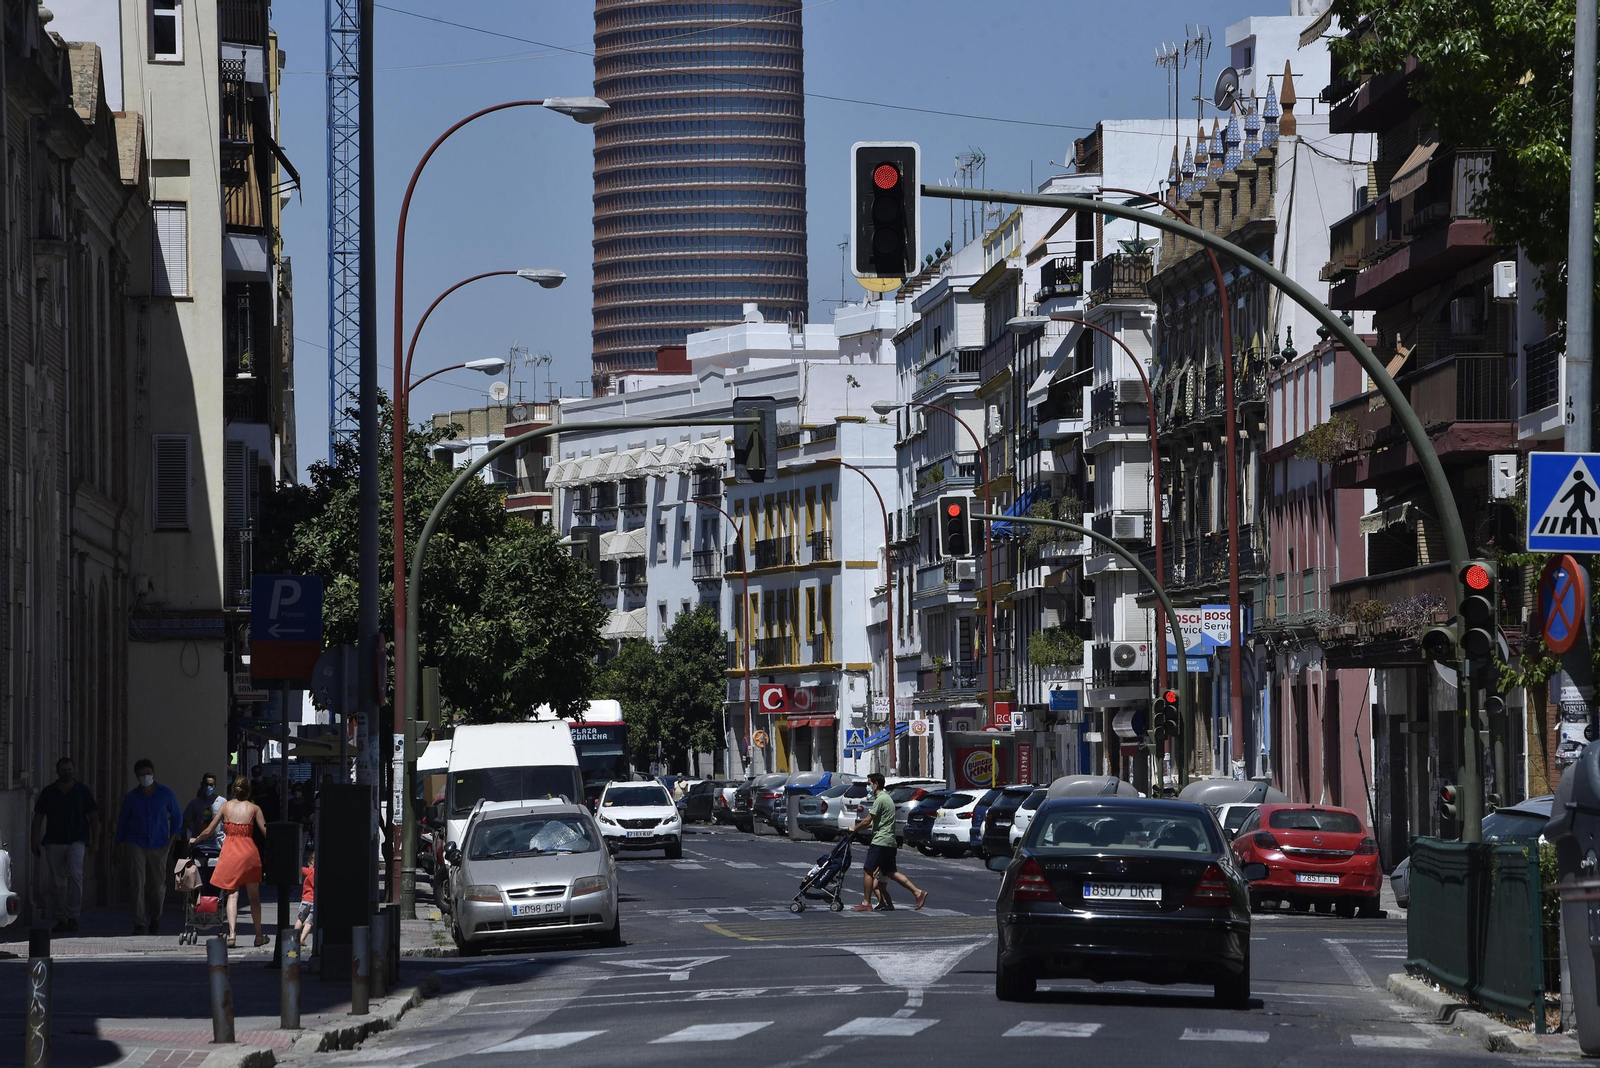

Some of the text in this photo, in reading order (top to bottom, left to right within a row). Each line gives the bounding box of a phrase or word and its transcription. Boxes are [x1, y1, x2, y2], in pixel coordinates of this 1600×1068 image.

[268, 579, 302, 620] P
[281, 610, 305, 618] Maristas
[1204, 612, 1231, 621] BOSC
[1165, 625, 1202, 634] Srvice
[1204, 622, 1231, 630] Servi
[571, 727, 598, 735] PLAZA
[1091, 884, 1125, 897] 8907
[1130, 885, 1155, 898] DKR
[519, 904, 541, 914] 6098
